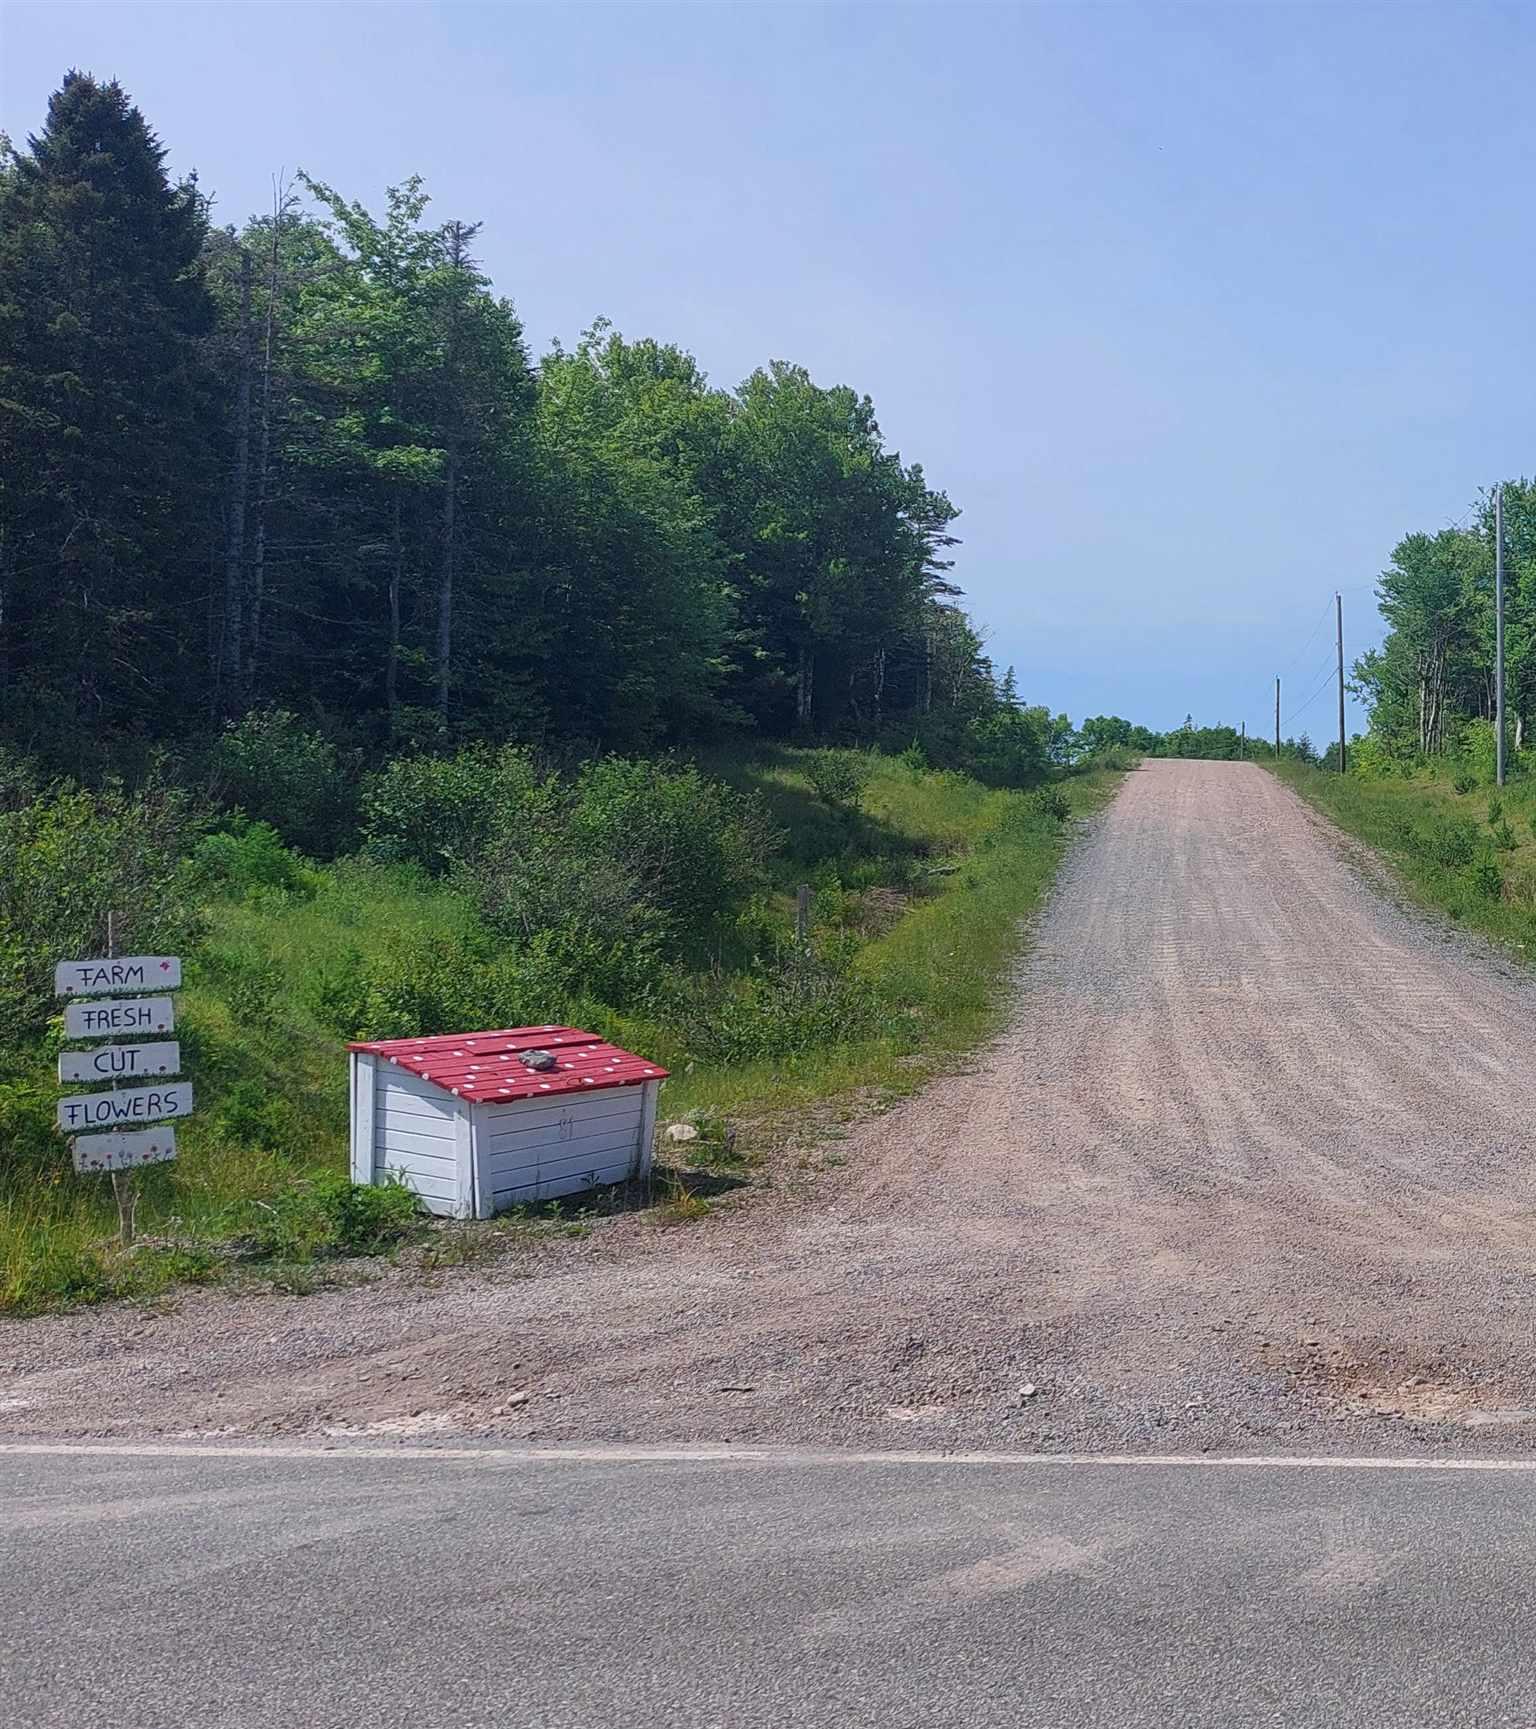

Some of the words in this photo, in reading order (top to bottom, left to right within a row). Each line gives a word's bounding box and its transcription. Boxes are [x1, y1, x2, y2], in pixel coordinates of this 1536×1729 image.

[75, 965, 145, 987] FARM
[81, 1007, 152, 1030] FRESH
[93, 1050, 141, 1073] CUT
[64, 1091, 179, 1125] FLOWERS
